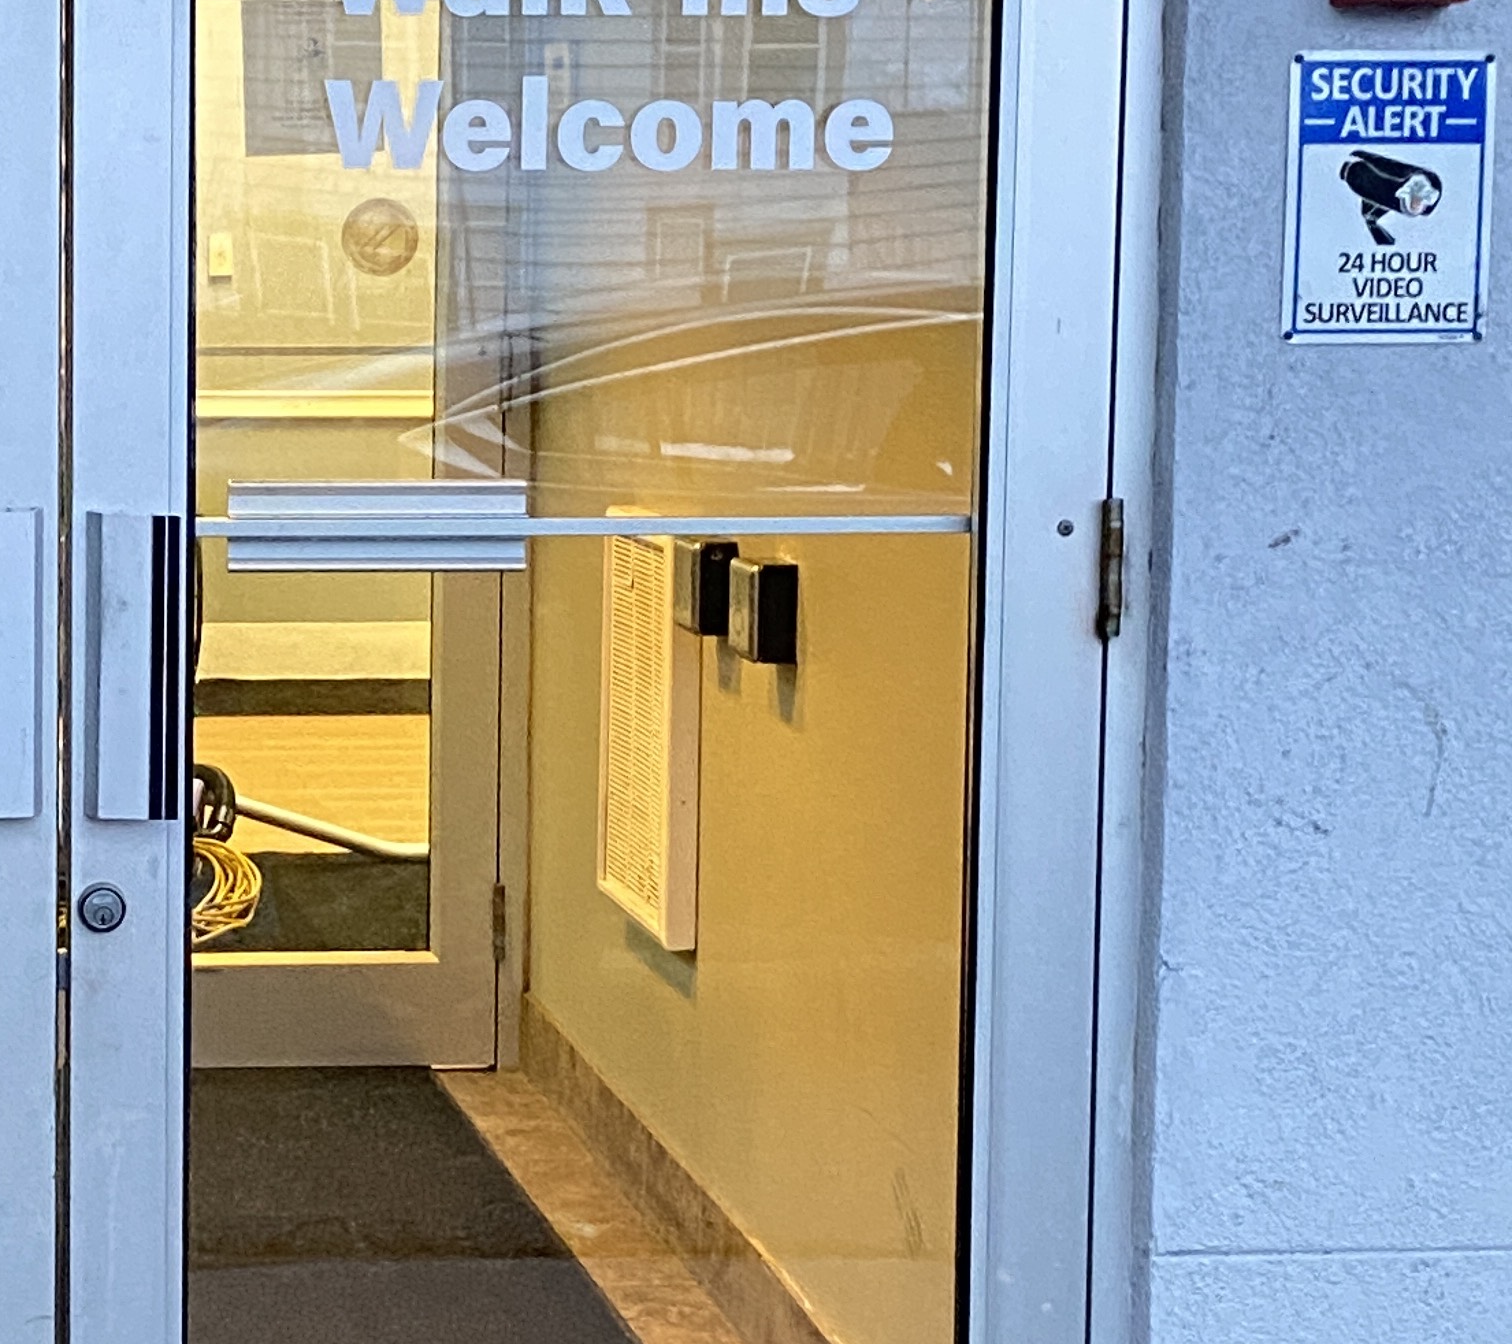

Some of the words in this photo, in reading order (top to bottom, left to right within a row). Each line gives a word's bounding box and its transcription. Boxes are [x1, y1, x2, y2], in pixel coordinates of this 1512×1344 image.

[1311, 67, 1478, 101] SECURITY
[324, 74, 895, 173] Welcome
[1340, 105, 1446, 138] ALERT
[1338, 252, 1364, 273] 24
[1371, 252, 1437, 273] HOUR
[1353, 277, 1423, 298] VIDEO
[1303, 302, 1468, 324] SURVEILLANCE
